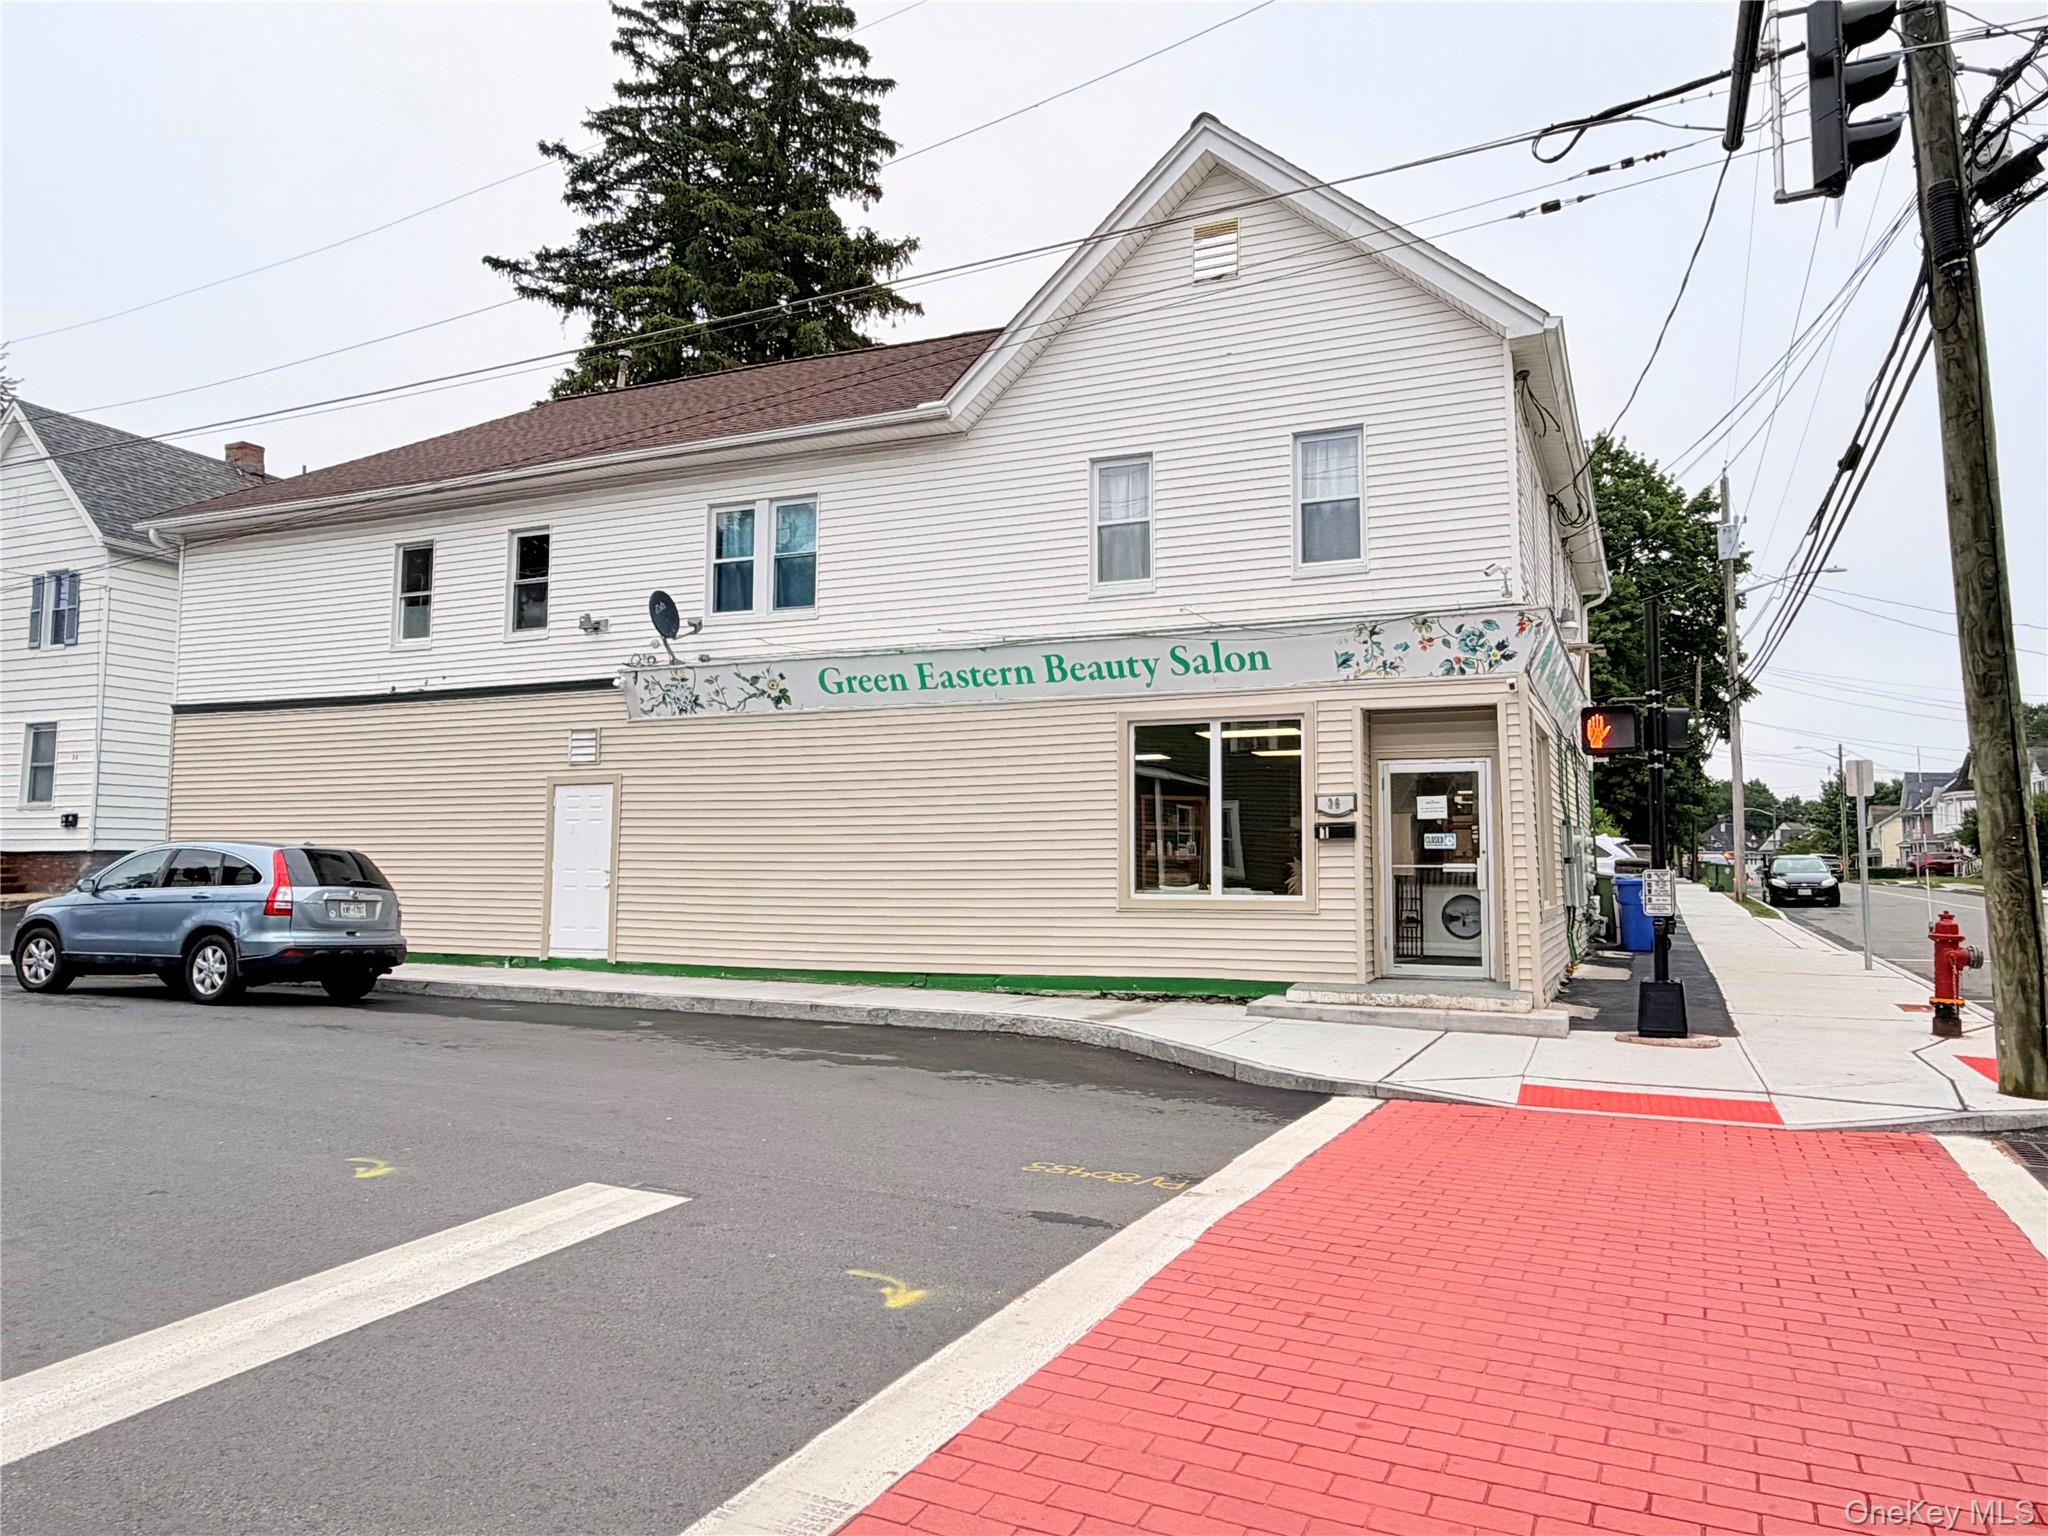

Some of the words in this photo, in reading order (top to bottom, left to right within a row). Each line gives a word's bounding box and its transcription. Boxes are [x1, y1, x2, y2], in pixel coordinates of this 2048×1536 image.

[818, 666, 909, 695] Green
[914, 661, 1036, 691] Eastern
[1041, 653, 1160, 688] Beauty
[1170, 639, 1272, 676] Salon
[1327, 797, 1340, 810] 36
[1425, 836, 1444, 844] CLOSED
